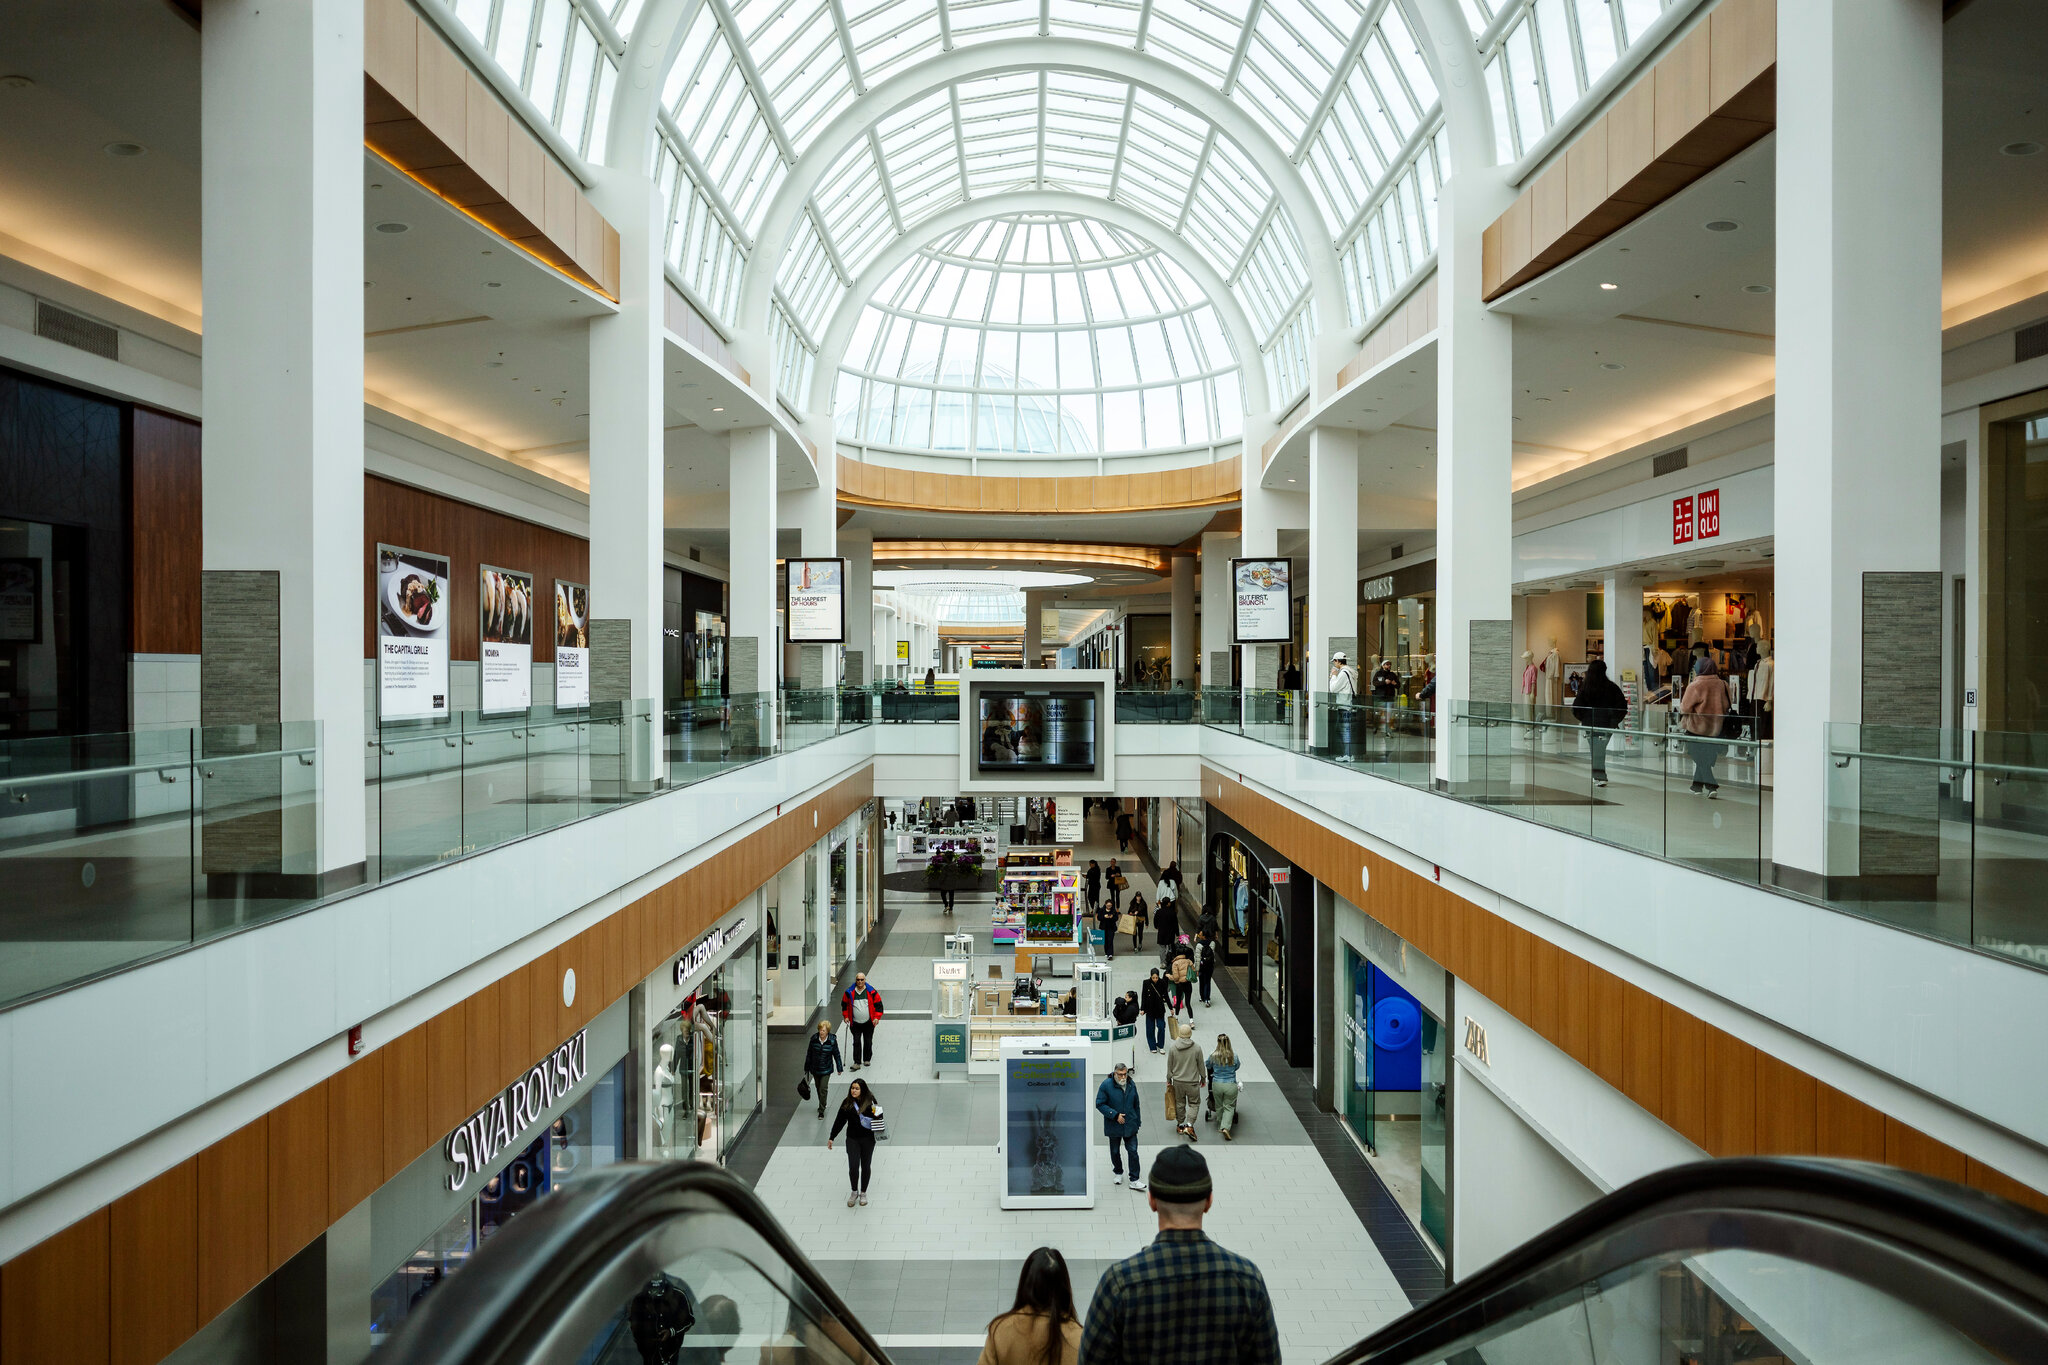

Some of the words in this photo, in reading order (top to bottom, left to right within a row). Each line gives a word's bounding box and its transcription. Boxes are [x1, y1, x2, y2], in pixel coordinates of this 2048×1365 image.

[1700, 495, 1717, 514] UNI
[1700, 515, 1718, 536] QLO
[384, 644, 394, 654] THE
[394, 644, 414, 655] CAPITAL
[414, 645, 429, 655] GRILLE
[1272, 872, 1287, 883] EXIT
[677, 927, 724, 986] CALZEDONIA
[940, 1034, 961, 1042] FREE
[1464, 1016, 1491, 1067] ZARA
[1021, 1061, 1050, 1070] Free
[1053, 1061, 1072, 1070] AR
[1013, 1071, 1080, 1079] Collectible!
[447, 1028, 588, 1191] SWAROVSKI
